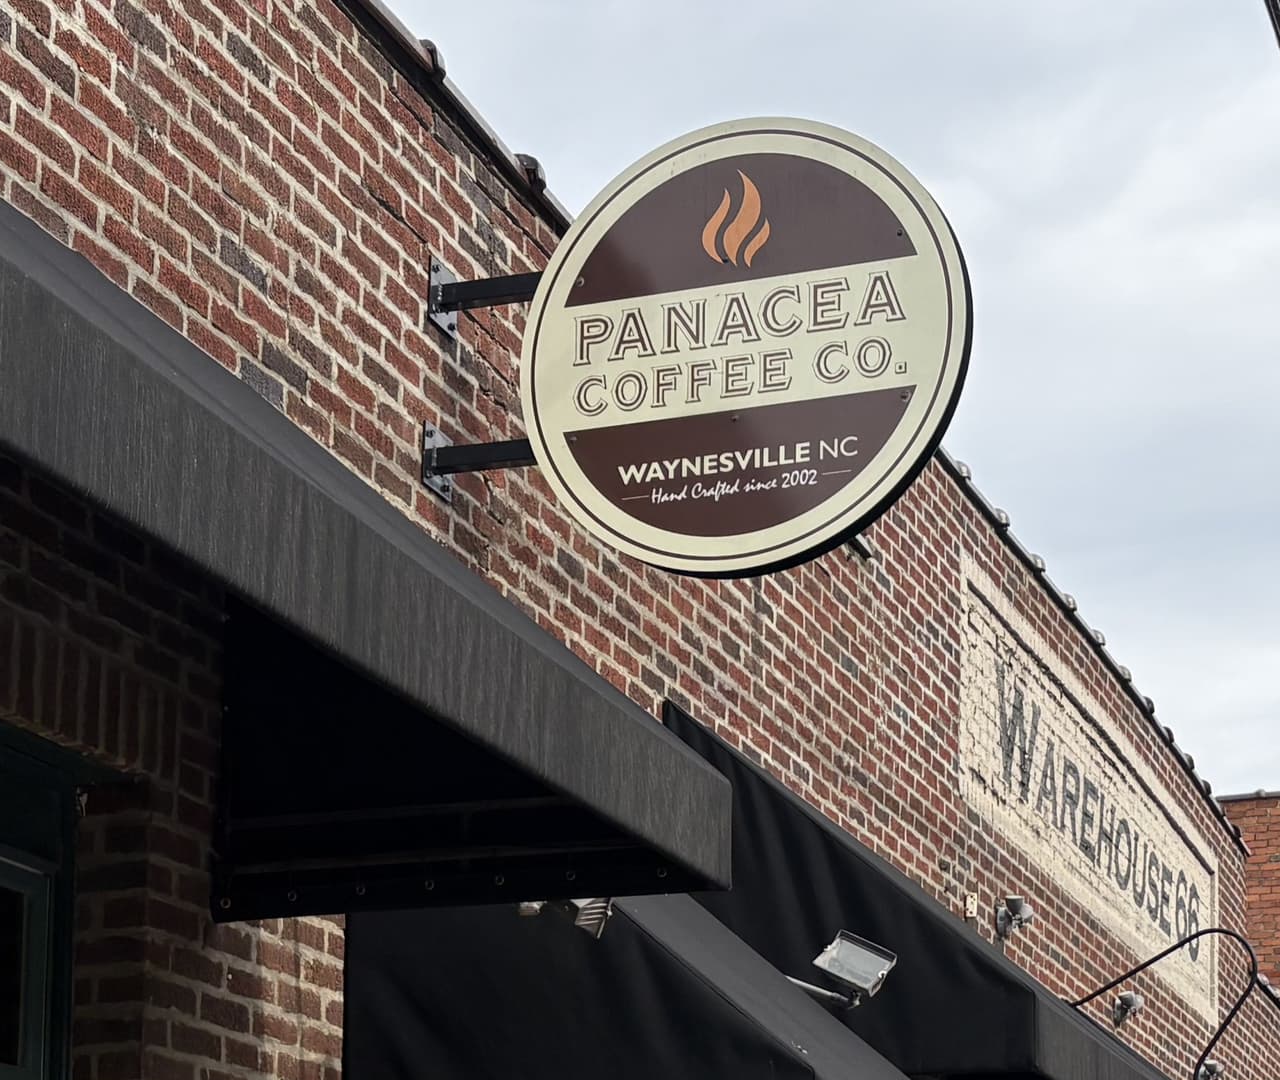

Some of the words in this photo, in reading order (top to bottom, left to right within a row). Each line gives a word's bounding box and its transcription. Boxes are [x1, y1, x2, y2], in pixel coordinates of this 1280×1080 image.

[573, 271, 907, 367] PANACEA
[573, 348, 794, 417] COFFEE
[812, 336, 908, 384] CO.
[618, 441, 811, 486] WAYNESVILLE
[819, 436, 859, 460] NC
[650, 484, 688, 504] Hand
[690, 479, 741, 502] Crafted
[743, 478, 778, 496] since
[781, 469, 818, 489] 2002
[1174, 869, 1201, 963] 66
